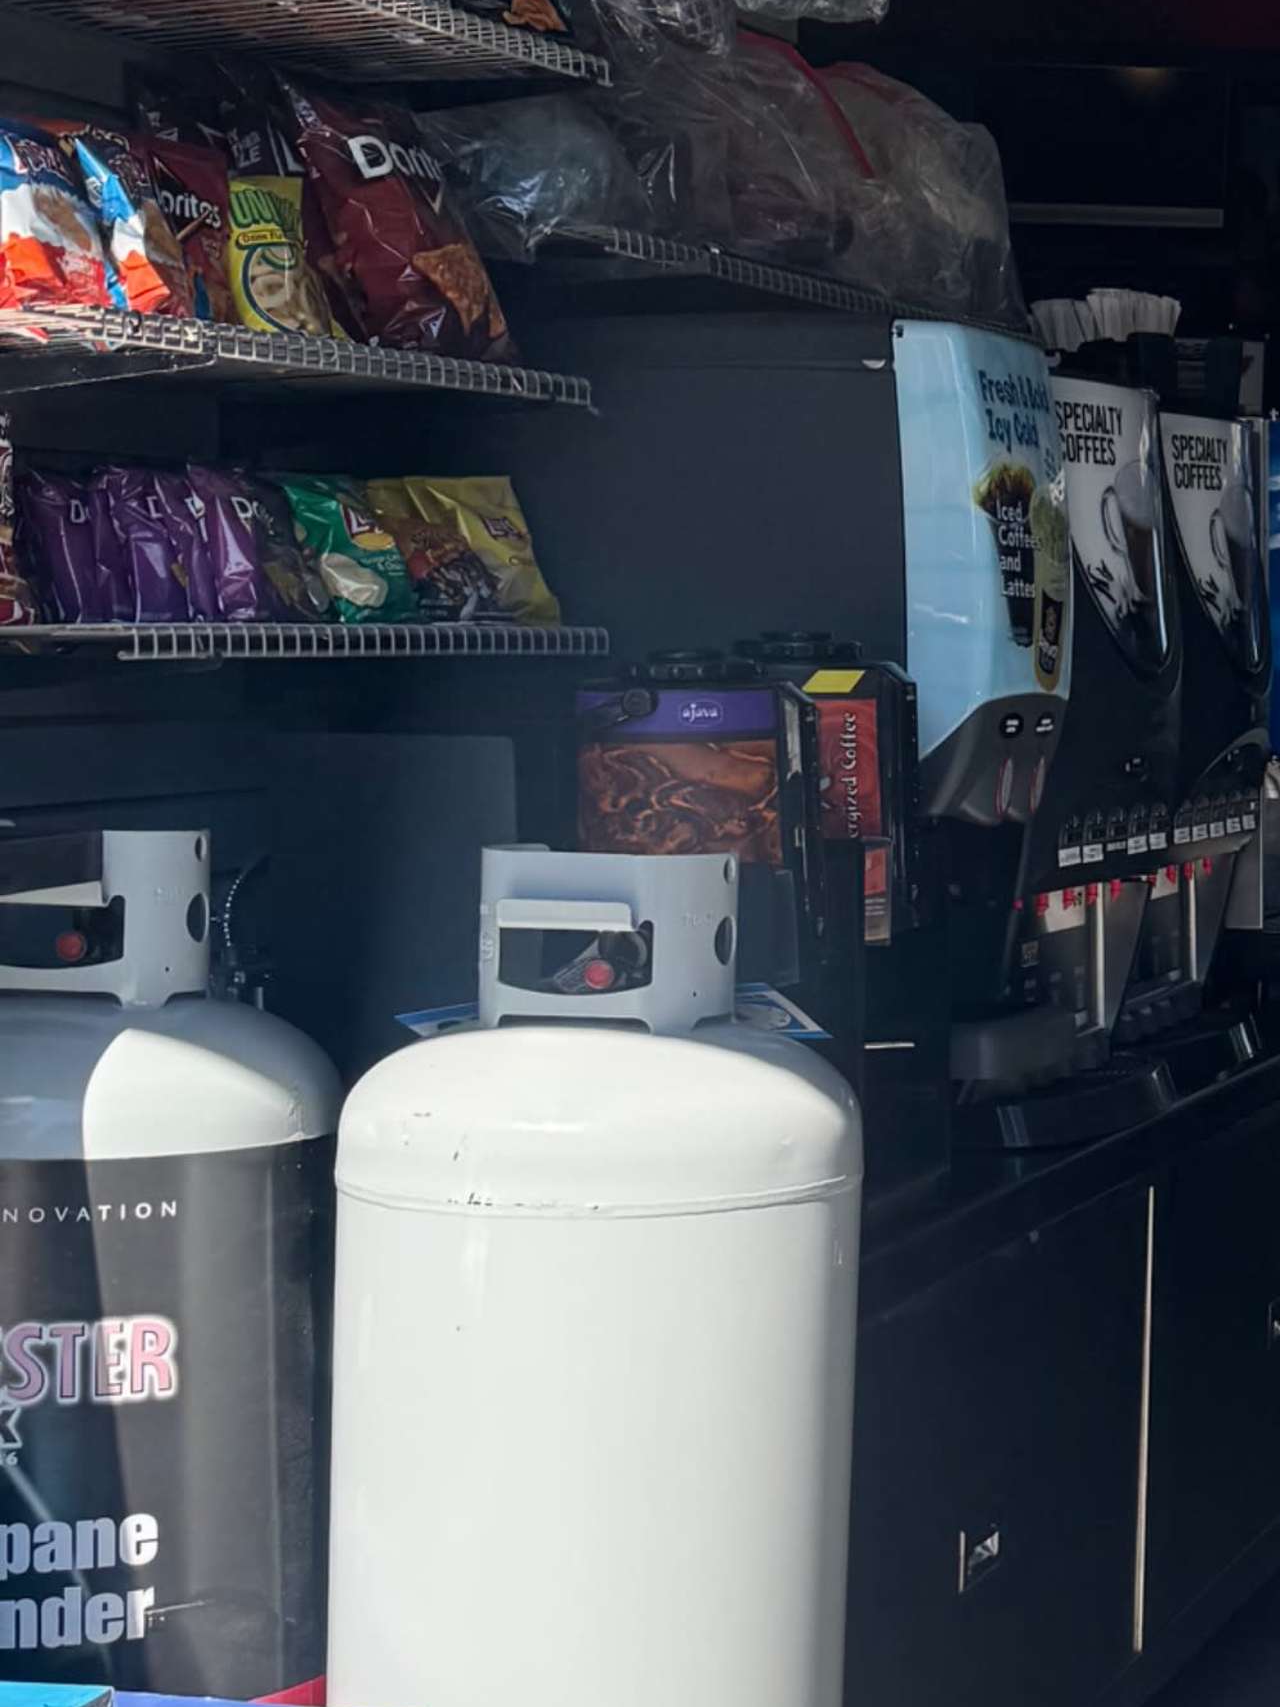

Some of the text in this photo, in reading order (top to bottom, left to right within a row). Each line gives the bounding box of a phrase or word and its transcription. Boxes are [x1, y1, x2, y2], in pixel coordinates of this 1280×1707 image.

[978, 368, 1019, 406] Fresh
[985, 408, 1040, 453] Icy Cold
[1055, 400, 1122, 436] SPECIALTY
[1171, 434, 1228, 465] SPECIALTY
[1174, 462, 1223, 491] COFFEES
[995, 500, 1023, 522] Iced
[998, 525, 1042, 550] Coffees
[998, 553, 1021, 572] and
[840, 712, 858, 771] Coffee
